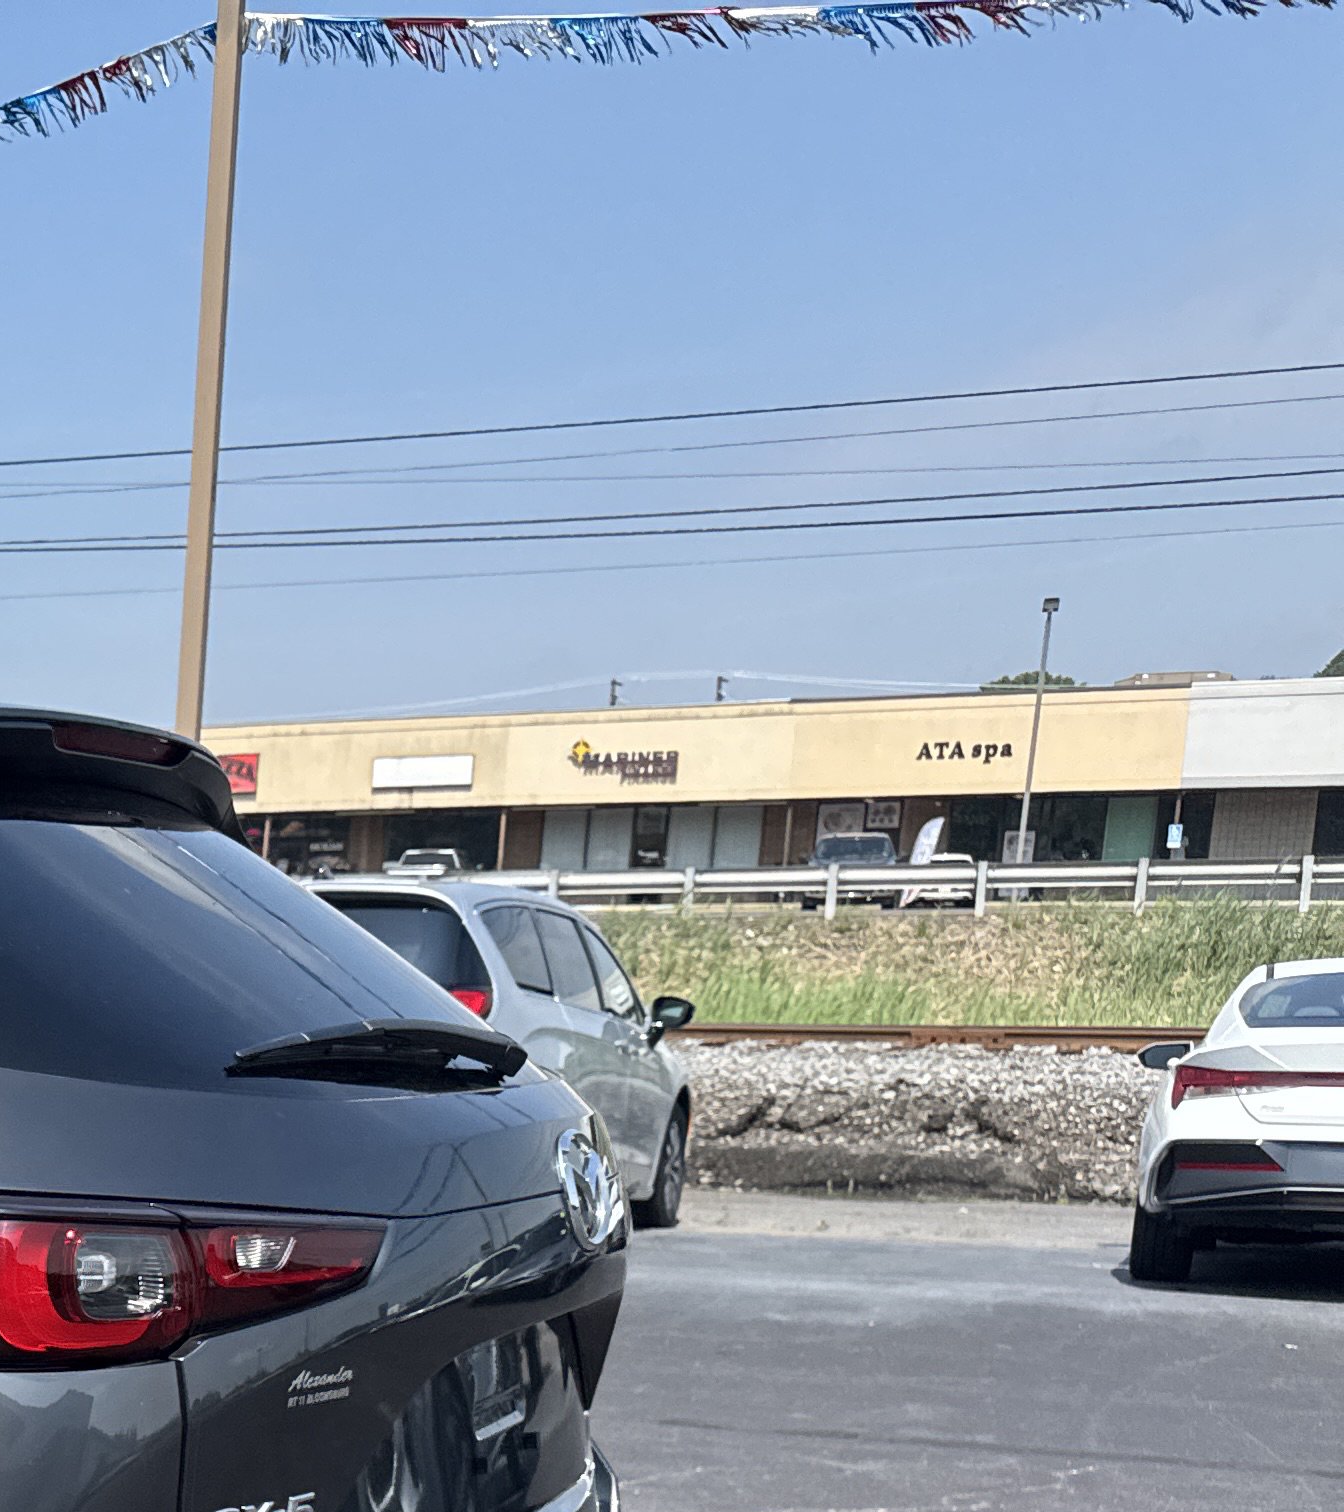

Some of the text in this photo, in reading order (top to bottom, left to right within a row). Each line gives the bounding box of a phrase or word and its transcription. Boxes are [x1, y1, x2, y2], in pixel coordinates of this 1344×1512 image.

[916, 741, 1012, 764] ATA spa
[288, 1366, 353, 1392] Alexander
